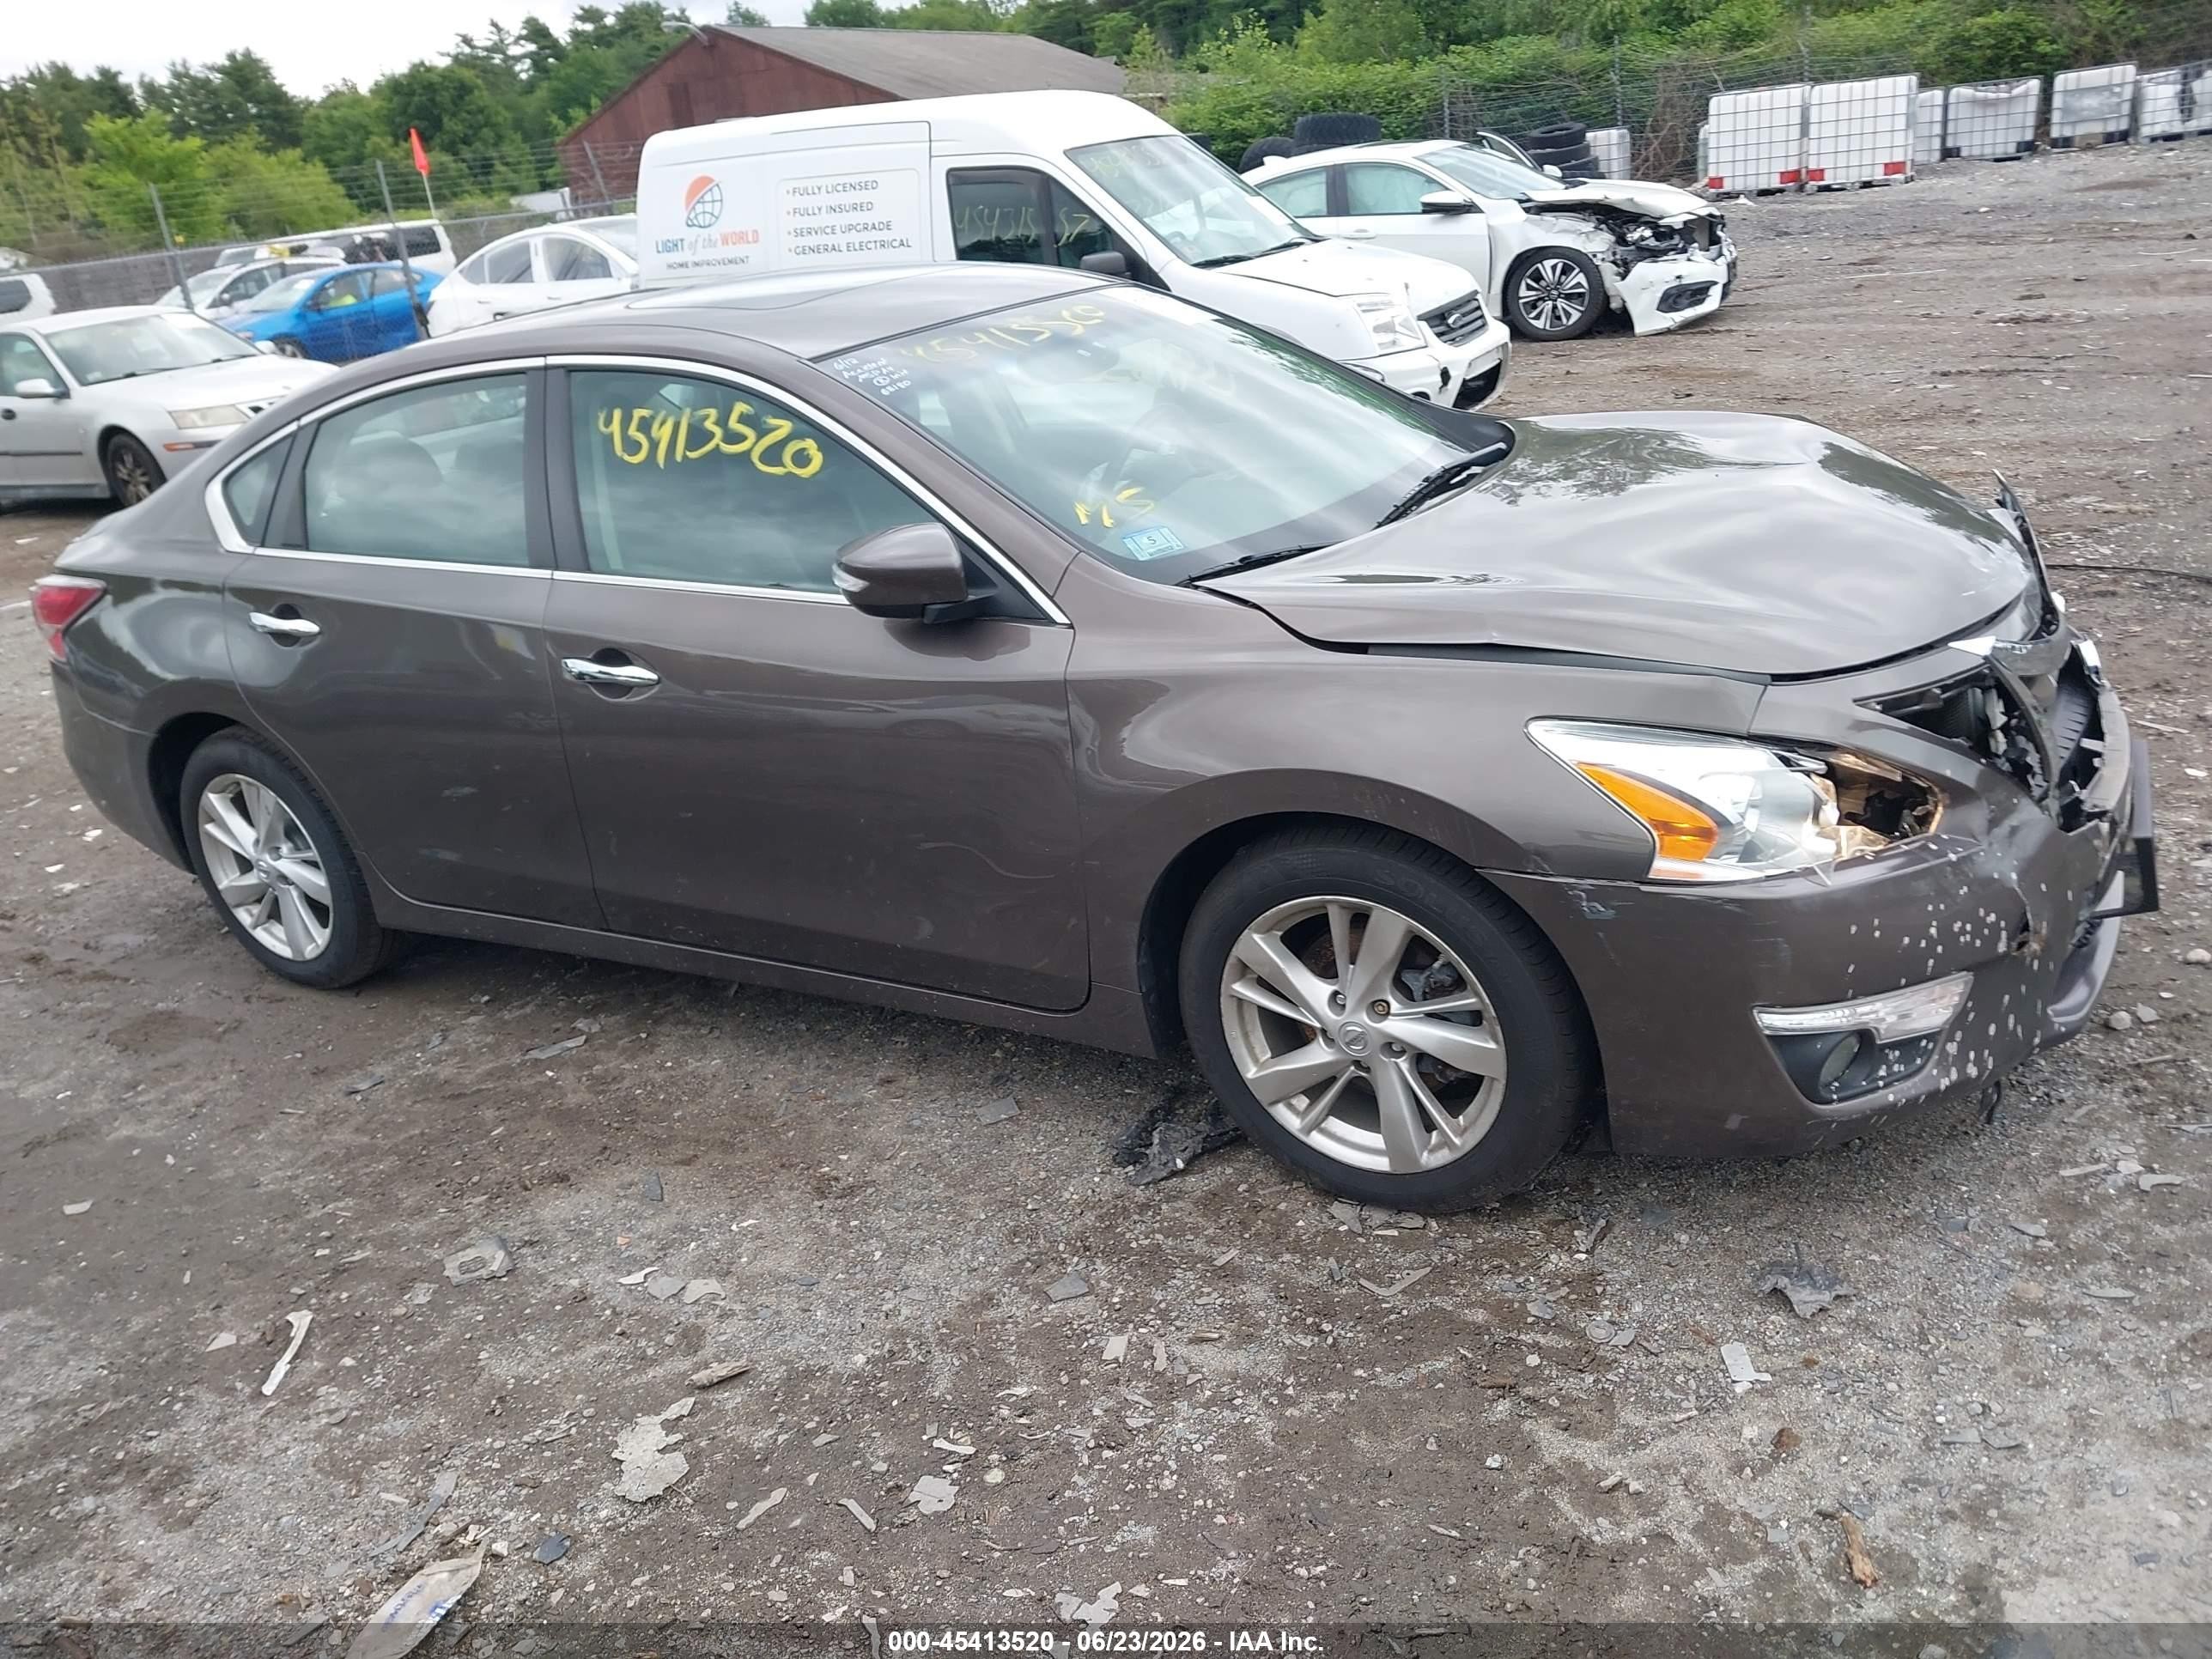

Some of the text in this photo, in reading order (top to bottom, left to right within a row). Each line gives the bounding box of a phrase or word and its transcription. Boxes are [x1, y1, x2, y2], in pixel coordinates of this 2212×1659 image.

[792, 179, 879, 197] FULLY LICENSED
[792, 201, 874, 217] FULLY INSURED
[793, 220, 893, 238] SERVICE UPGRADE
[655, 228, 759, 256] LIGHT of the WORLD
[793, 238, 913, 256] GENERAL ELECTRICAL
[665, 255, 750, 270] HOME IMPROVEMENT
[598, 400, 824, 478] 45413520
